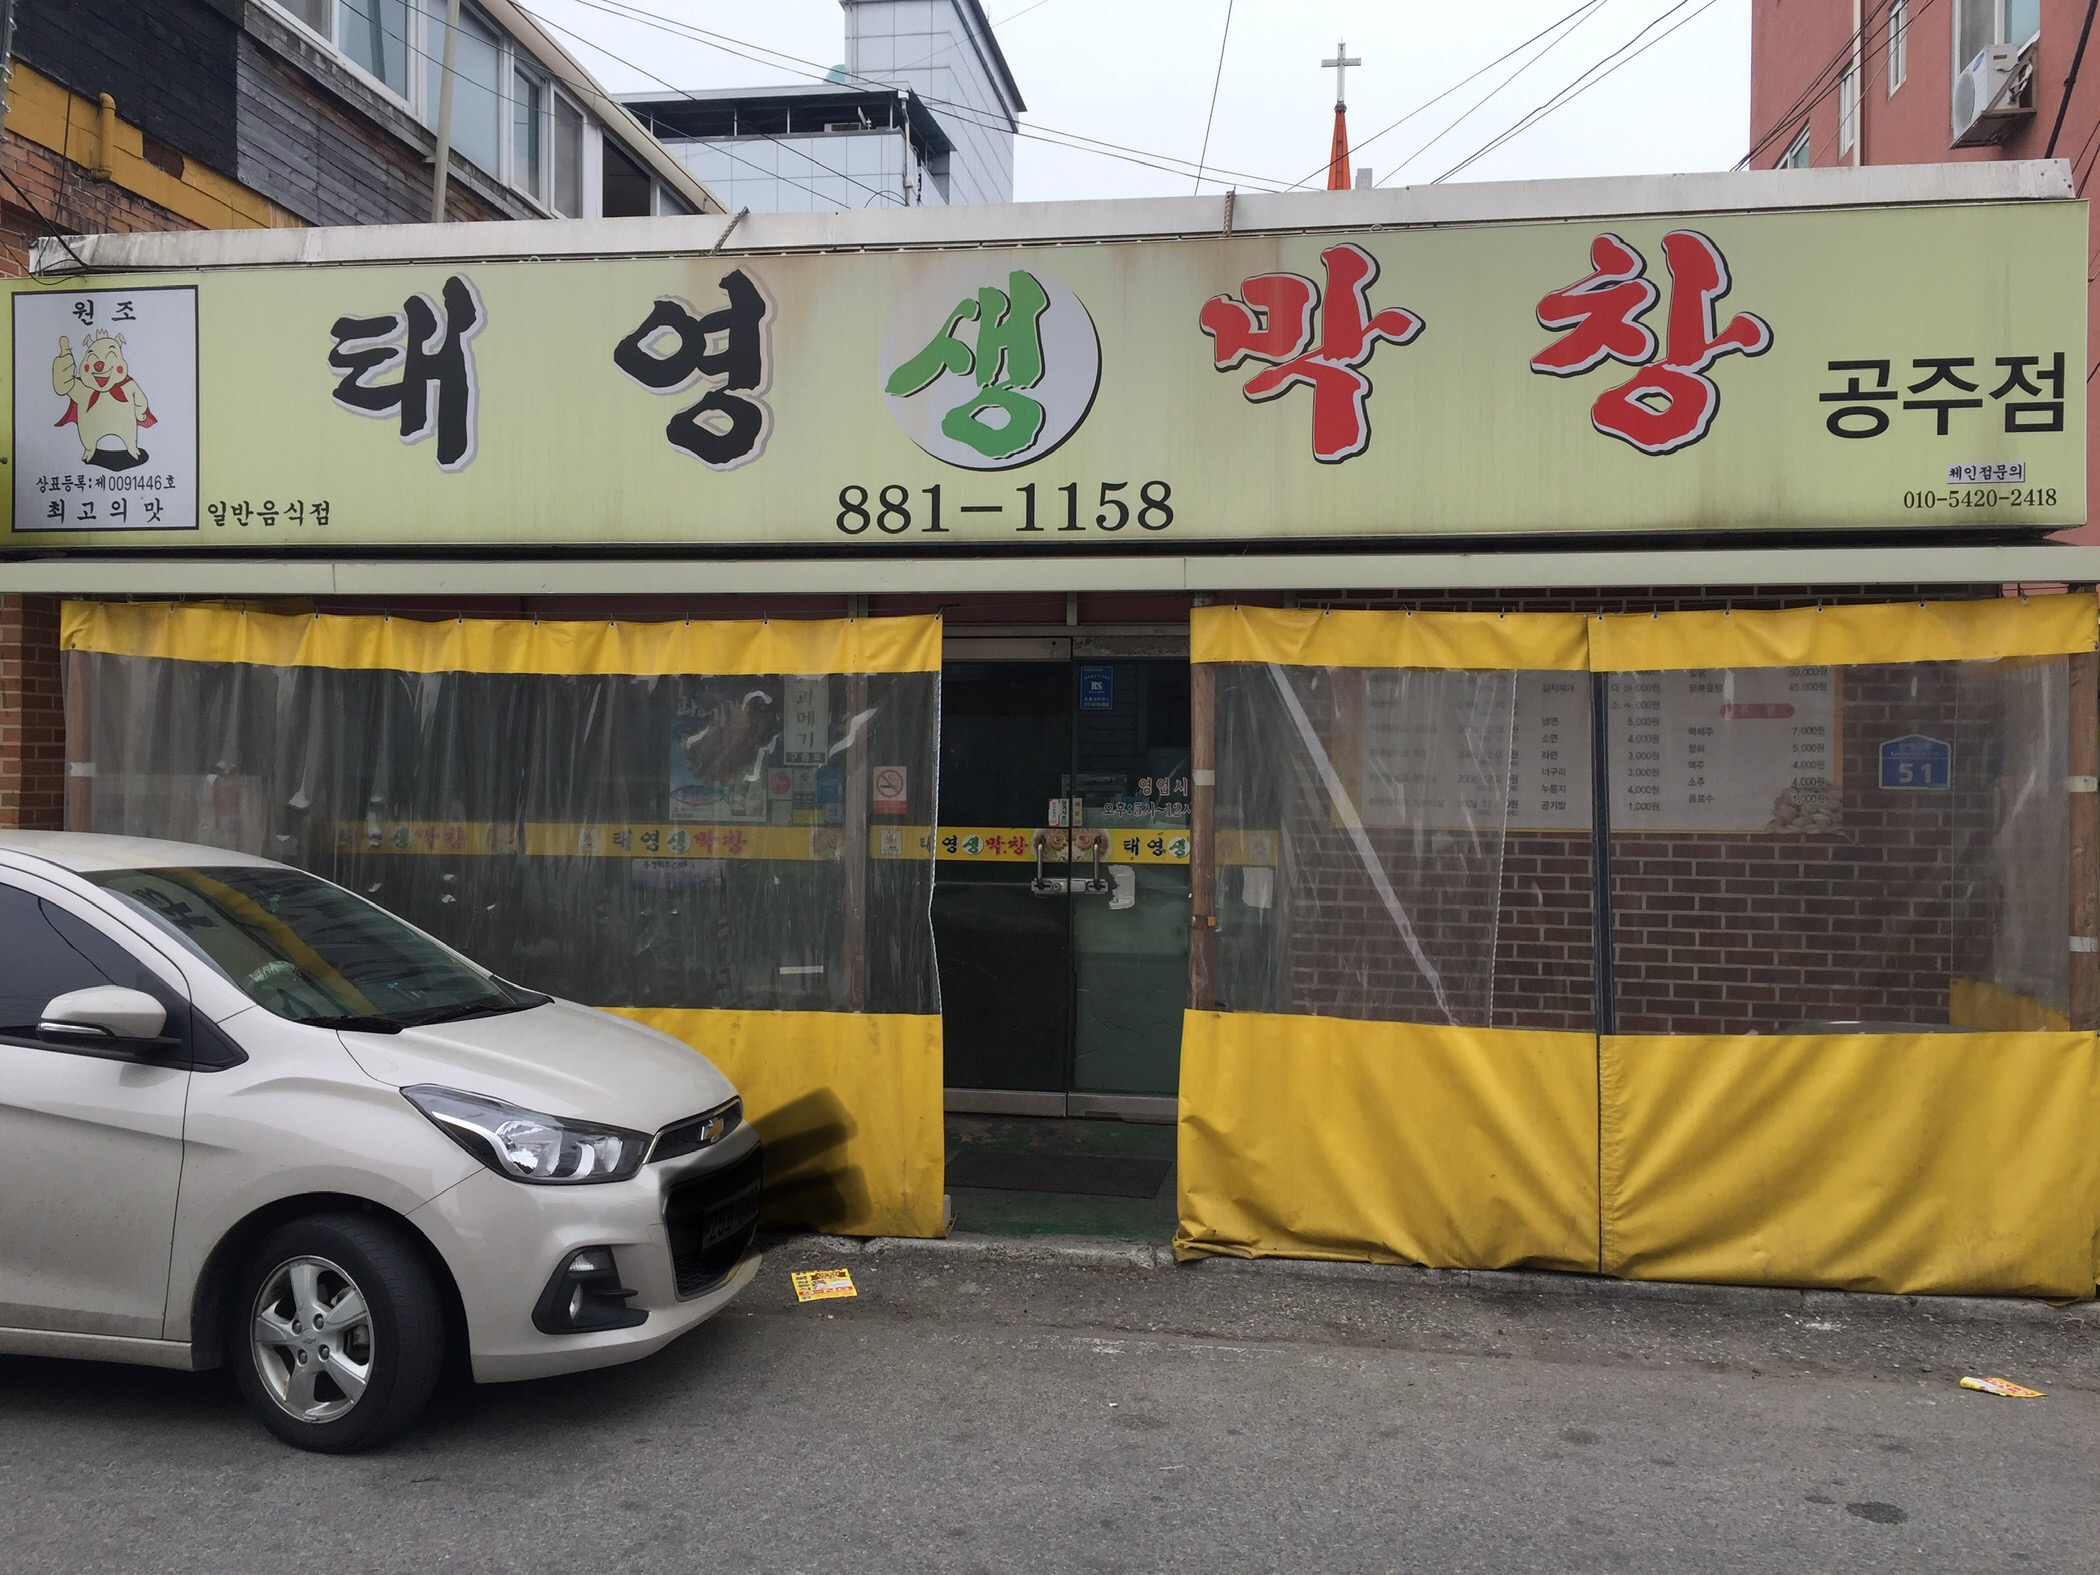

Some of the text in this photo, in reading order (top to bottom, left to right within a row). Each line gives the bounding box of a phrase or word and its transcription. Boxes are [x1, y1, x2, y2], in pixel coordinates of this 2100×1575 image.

[72, 299, 138, 326] 원조
[1819, 352, 2066, 439] 공주점
[1948, 464, 2023, 481] 체인점문의
[1903, 488, 2058, 509] 010-5420-2418
[836, 479, 1175, 535] 881-1158
[206, 499, 332, 528] 일반음식점
[1792, 726, 1826, 735] 7,000원
[1792, 743, 1825, 753] 5,000원
[1541, 751, 1660, 761] 라면 3,000원
[1792, 760, 1825, 770] 4,000원
[1541, 768, 1660, 777] 너구리 3,000원
[1898, 761, 1932, 785] 51
[1687, 776, 1826, 787] 소주 4,000원
[1627, 784, 1660, 795] 4,000원
[1541, 801, 1660, 812] 공기밥 1,000원
